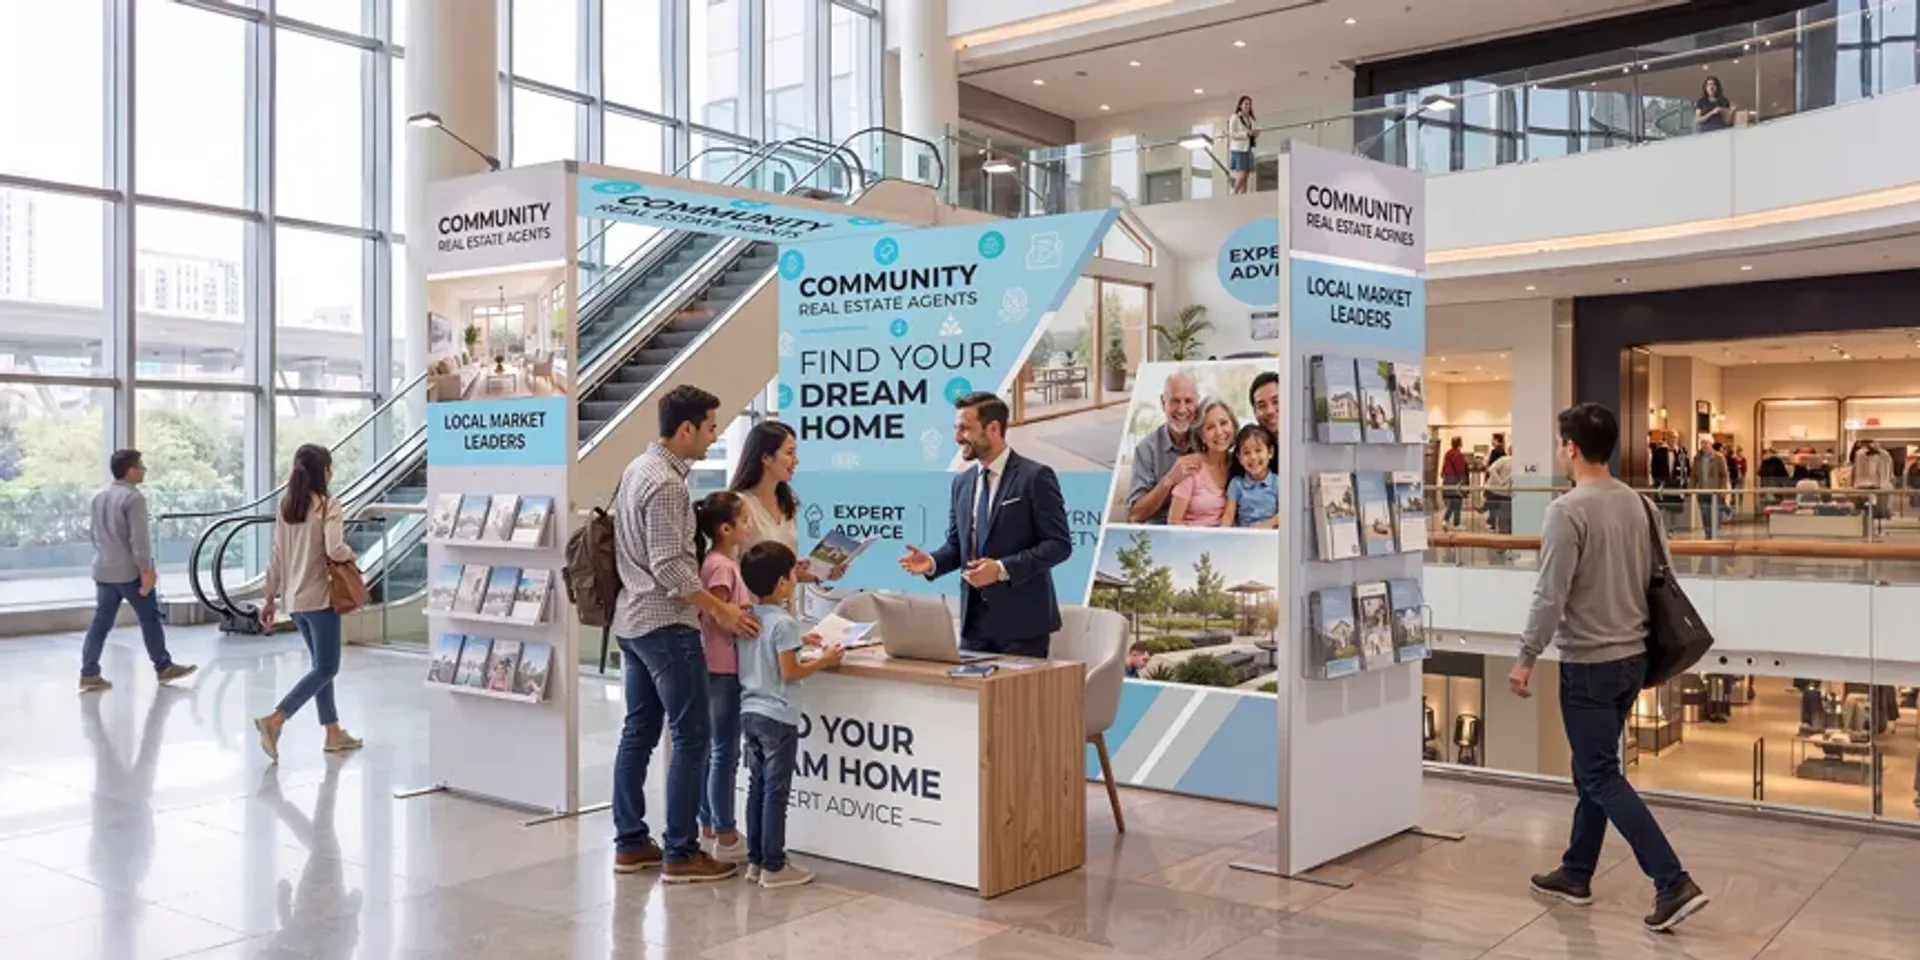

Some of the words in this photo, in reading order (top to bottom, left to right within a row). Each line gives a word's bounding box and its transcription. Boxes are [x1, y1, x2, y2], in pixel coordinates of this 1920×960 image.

[438, 202, 551, 235] COMMUNITY
[595, 204, 650, 217] REAL
[653, 212, 722, 229] ESTATE
[618, 195, 833, 232] COMMUNITY
[1306, 184, 1413, 226] COMMUNITY
[438, 239, 465, 252] REAL
[466, 231, 503, 249] ESTATE
[506, 226, 551, 243] AGENTS
[1306, 212, 1334, 232] REAL
[1336, 218, 1372, 239] ESTATE
[800, 263, 978, 297] COMMUNITY
[1307, 275, 1354, 300] LOCAL
[1357, 283, 1412, 308] MARKET
[799, 302, 839, 317] REAL
[844, 296, 903, 314] ESTATE
[907, 291, 978, 309] AGENTS
[1330, 304, 1393, 330] LEADERS
[801, 348, 880, 375] FIND
[889, 341, 992, 371] YOUR
[801, 378, 927, 408] DREAM
[444, 413, 487, 430] LOCAL
[489, 411, 546, 429] MARKET
[801, 414, 905, 440] HOME
[464, 433, 527, 450] LEADERS
[833, 504, 905, 521] EXPERT
[835, 523, 904, 540] ADVICE
[821, 714, 914, 757] YOUR
[839, 756, 942, 801] HOME
[824, 796, 904, 828] ADVICE
